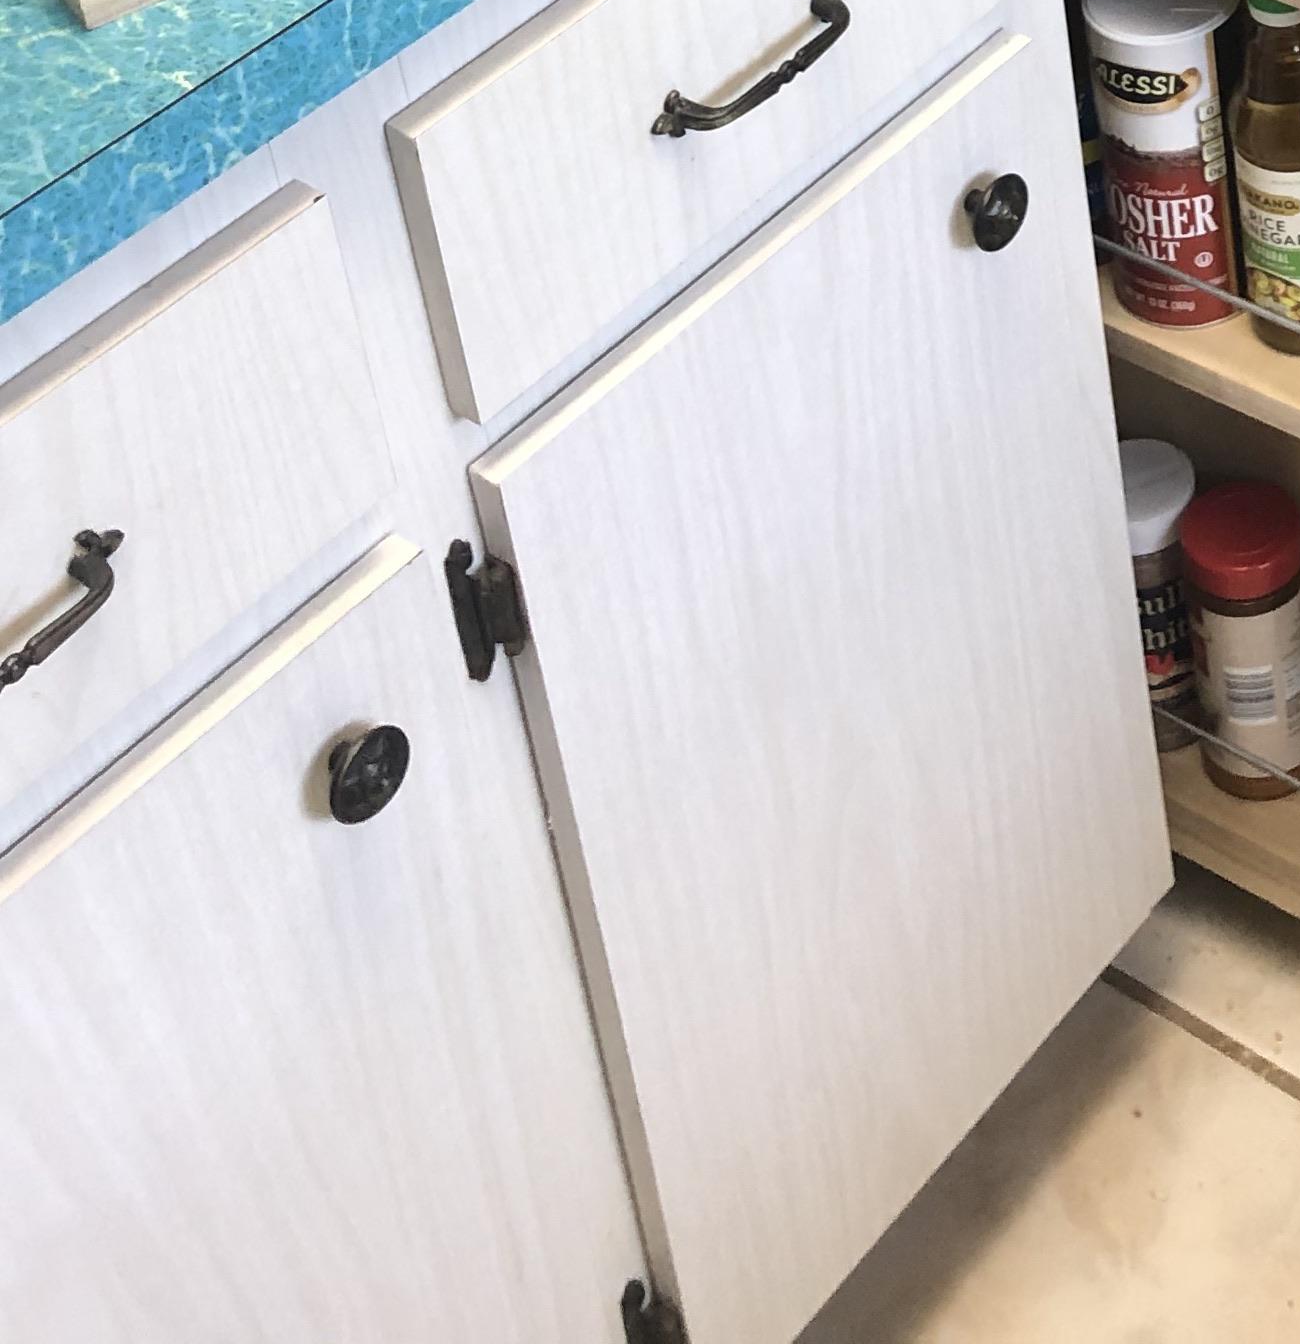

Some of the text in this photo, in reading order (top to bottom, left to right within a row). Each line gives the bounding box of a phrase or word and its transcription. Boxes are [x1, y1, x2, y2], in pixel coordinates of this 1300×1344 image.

[1096, 63, 1176, 97] ALESSI
[1109, 183, 1220, 240] OSHER
[1248, 210, 1286, 233] RICE
[1123, 229, 1181, 262] SALT
